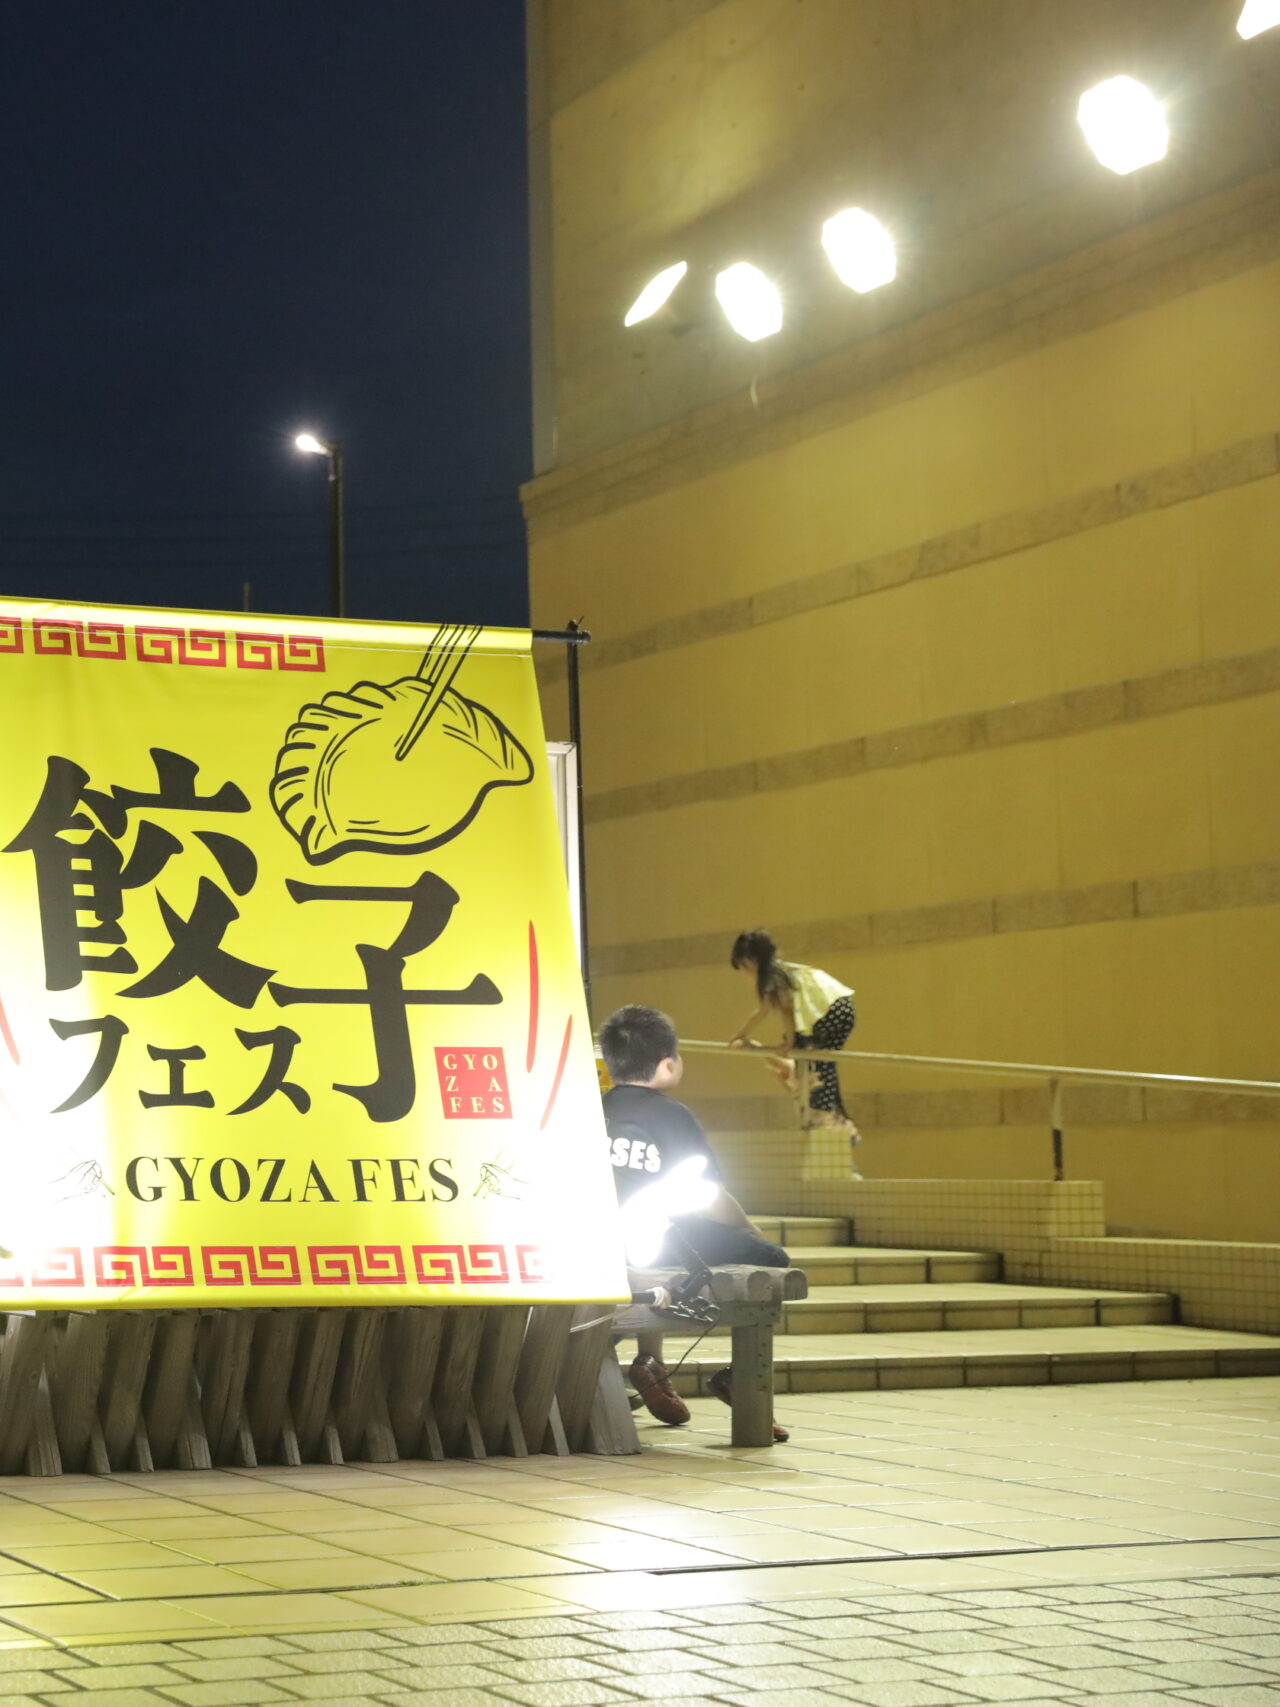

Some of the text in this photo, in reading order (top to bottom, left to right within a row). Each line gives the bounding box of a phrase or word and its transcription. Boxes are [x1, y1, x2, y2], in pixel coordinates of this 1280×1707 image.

[0, 747, 504, 1123] 餃子
[48, 1014, 312, 1116] フェス
[442, 1053, 499, 1071] GYO
[449, 1096, 506, 1113] FES
[125, 1155, 459, 1203] GYOZA FES
